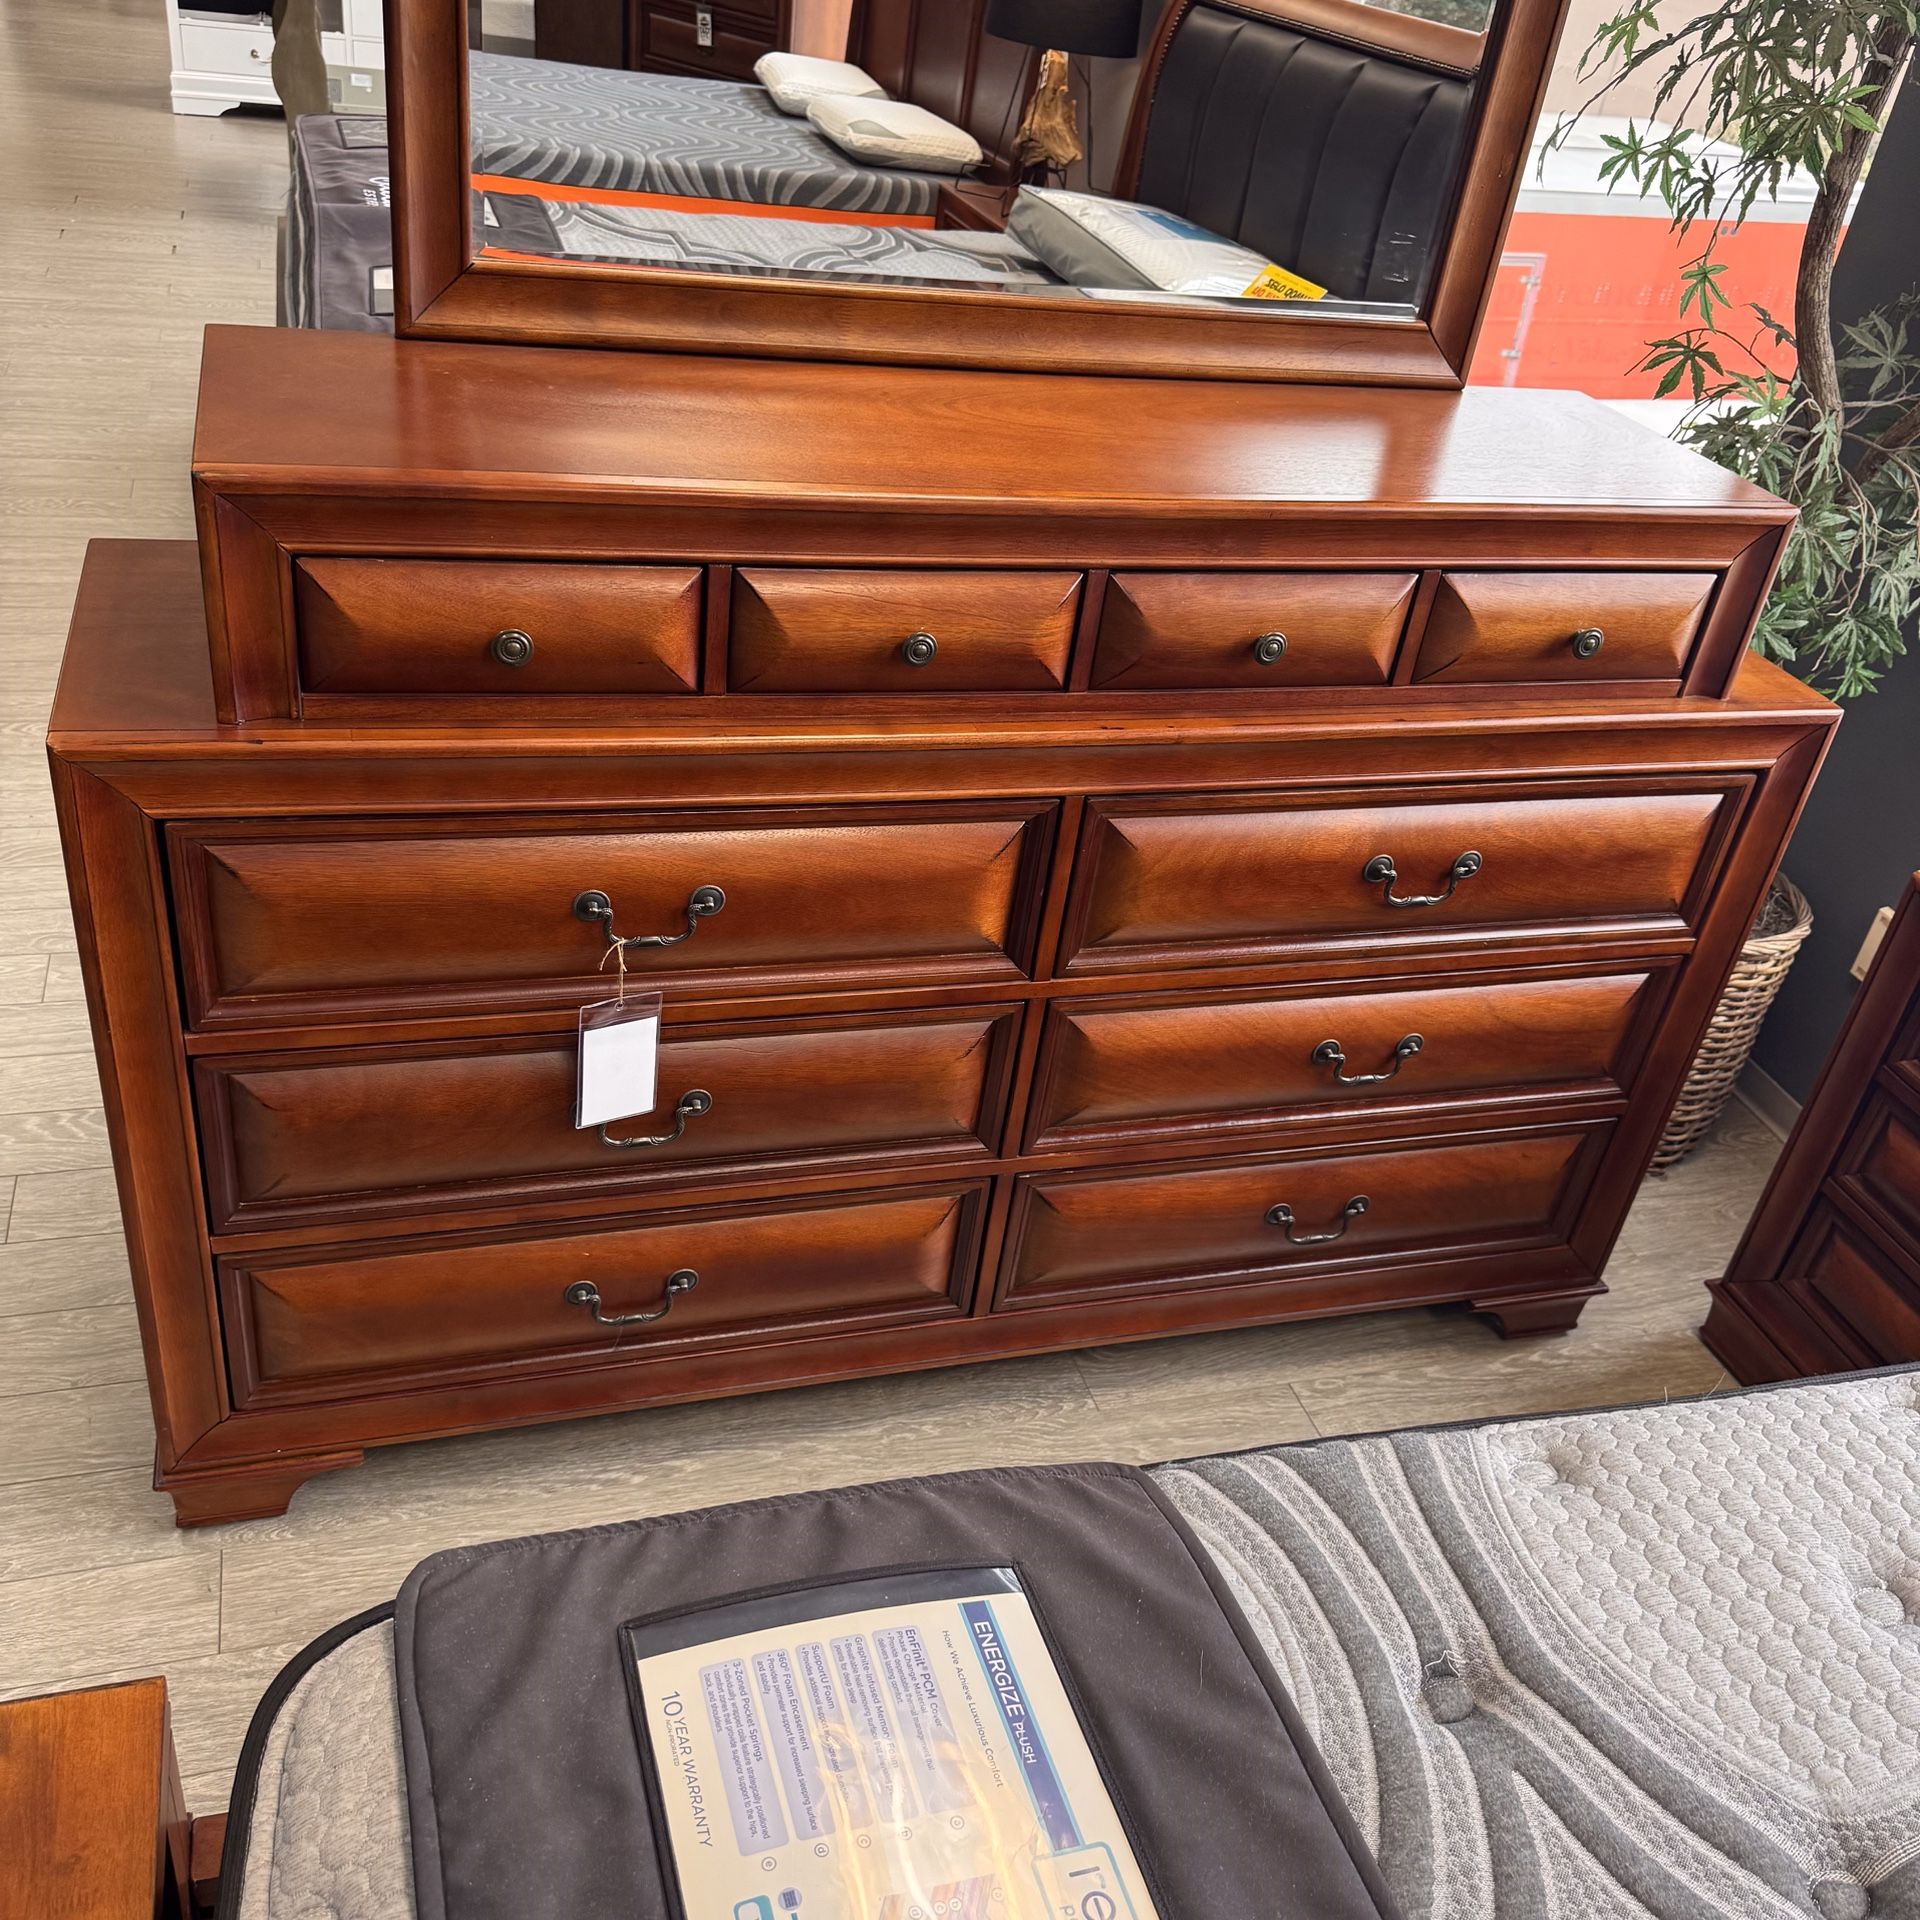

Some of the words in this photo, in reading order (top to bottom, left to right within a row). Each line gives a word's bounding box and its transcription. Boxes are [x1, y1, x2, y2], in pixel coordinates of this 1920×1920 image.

[876, 1637, 891, 1660] delivers
[941, 1629, 955, 1649] How
[756, 1659, 766, 1671] and
[833, 1644, 845, 1662] points
[843, 1642, 860, 1673] Breathable
[948, 1649, 961, 1665] We
[732, 1661, 748, 1696] 3-Zoned
[766, 1657, 780, 1684] Provides
[810, 1644, 829, 1683] SupportU
[822, 1684, 836, 1709] Foam
[839, 1662, 848, 1671] for
[841, 1671, 853, 1687] deep
[883, 1660, 897, 1679] lasting
[892, 1657, 911, 1692] dependable
[894, 1630, 908, 1652] Phase
[901, 1653, 918, 1681] Change
[911, 1682, 929, 1713] Material
[712, 1670, 724, 1693] comfort
[721, 1667, 737, 1701] Individually
[757, 1672, 772, 1695] stability
[782, 1673, 796, 1697] Foam
[800, 1650, 814, 1675] Provides
[808, 1676, 822, 1705] additional
[815, 1705, 829, 1728] support
[919, 1672, 938, 1699] PCM
[954, 1666, 974, 1701] Achieve
[972, 1620, 1025, 1717] ENERGIZE
[1011, 1721, 1037, 1763] PLUSH
[659, 1690, 684, 1717] 10
[707, 1690, 717, 1702] and
[718, 1693, 728, 1712] zones
[772, 1683, 787, 1712] perimeter
[845, 1687, 858, 1704] sleep
[852, 1636, 881, 1703] Graphite-Infused
[873, 1704, 892, 1740] Memory
[885, 1742, 901, 1768] Foam
[904, 1692, 919, 1715] thermal
[722, 1712, 732, 1725] that
[729, 1701, 743, 1728] wrapped
[741, 1697, 756, 1727] Pocket
[780, 1712, 794, 1736] support
[788, 1698, 810, 1750] Encasement
[928, 1702, 944, 1727] Cover
[967, 1702, 991, 1746] Luxurious
[673, 1716, 692, 1755] YEAR
[724, 1725, 737, 1748] provide
[737, 1728, 747, 1743] coils
[747, 1728, 764, 1761] Springs
[787, 1736, 797, 1746] for
[910, 1716, 931, 1757] management
[730, 1748, 744, 1774] superior
[740, 1743, 753, 1765] feature
[789, 1746, 805, 1777] increased
[925, 1758, 936, 1771] that
[983, 1747, 1006, 1787] Comfort
[736, 1775, 750, 1800] support
[744, 1766, 762, 1804] strategically
[796, 1777, 812, 1805] sleeping
[682, 1758, 712, 1847] WARRANTY
[745, 1808, 755, 1819] the
[754, 1805, 770, 1839] positioned
[805, 1805, 819, 1830] surface
